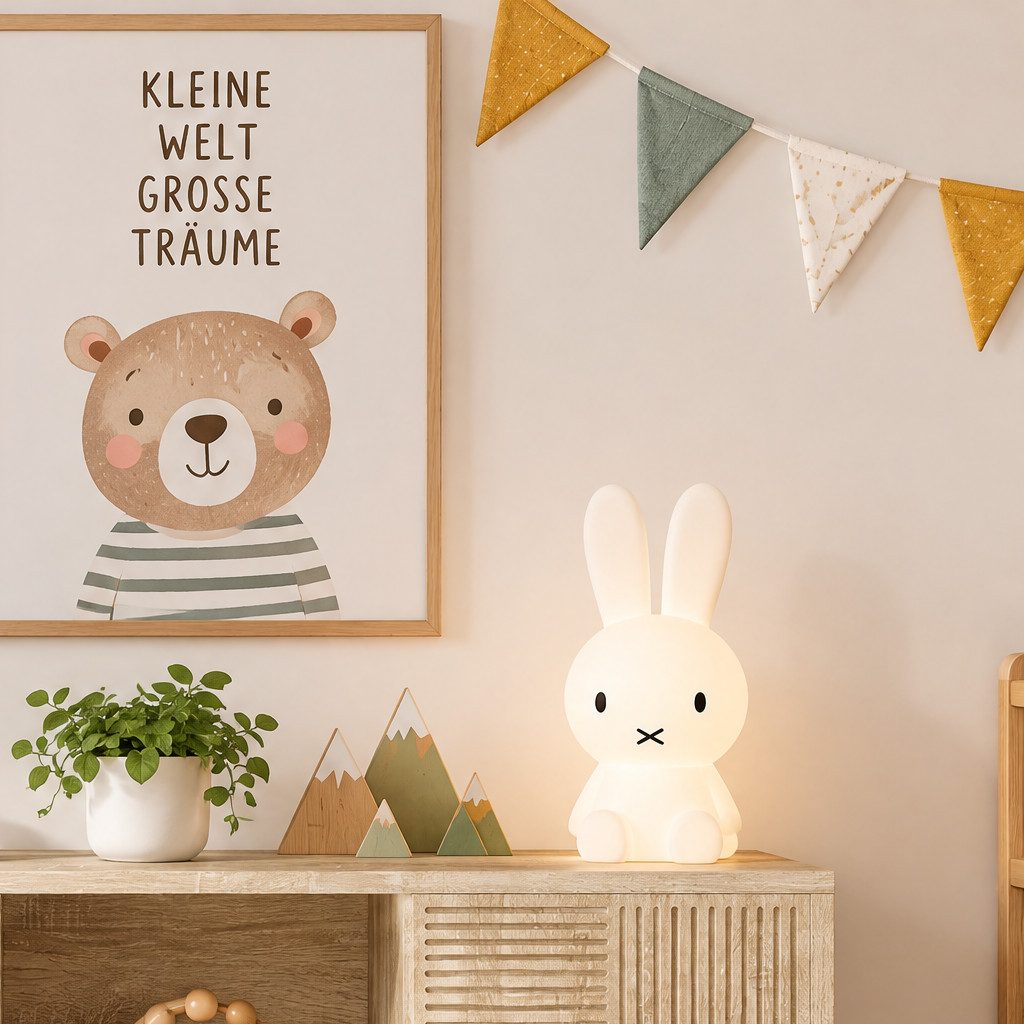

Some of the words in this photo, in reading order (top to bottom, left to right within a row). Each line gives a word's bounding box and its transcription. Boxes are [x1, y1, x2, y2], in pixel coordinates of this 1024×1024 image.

[143, 71, 270, 108] KLEINE
[159, 123, 257, 160] WELT
[139, 175, 271, 213] GROSSE
[132, 222, 280, 266] TRÄUME
